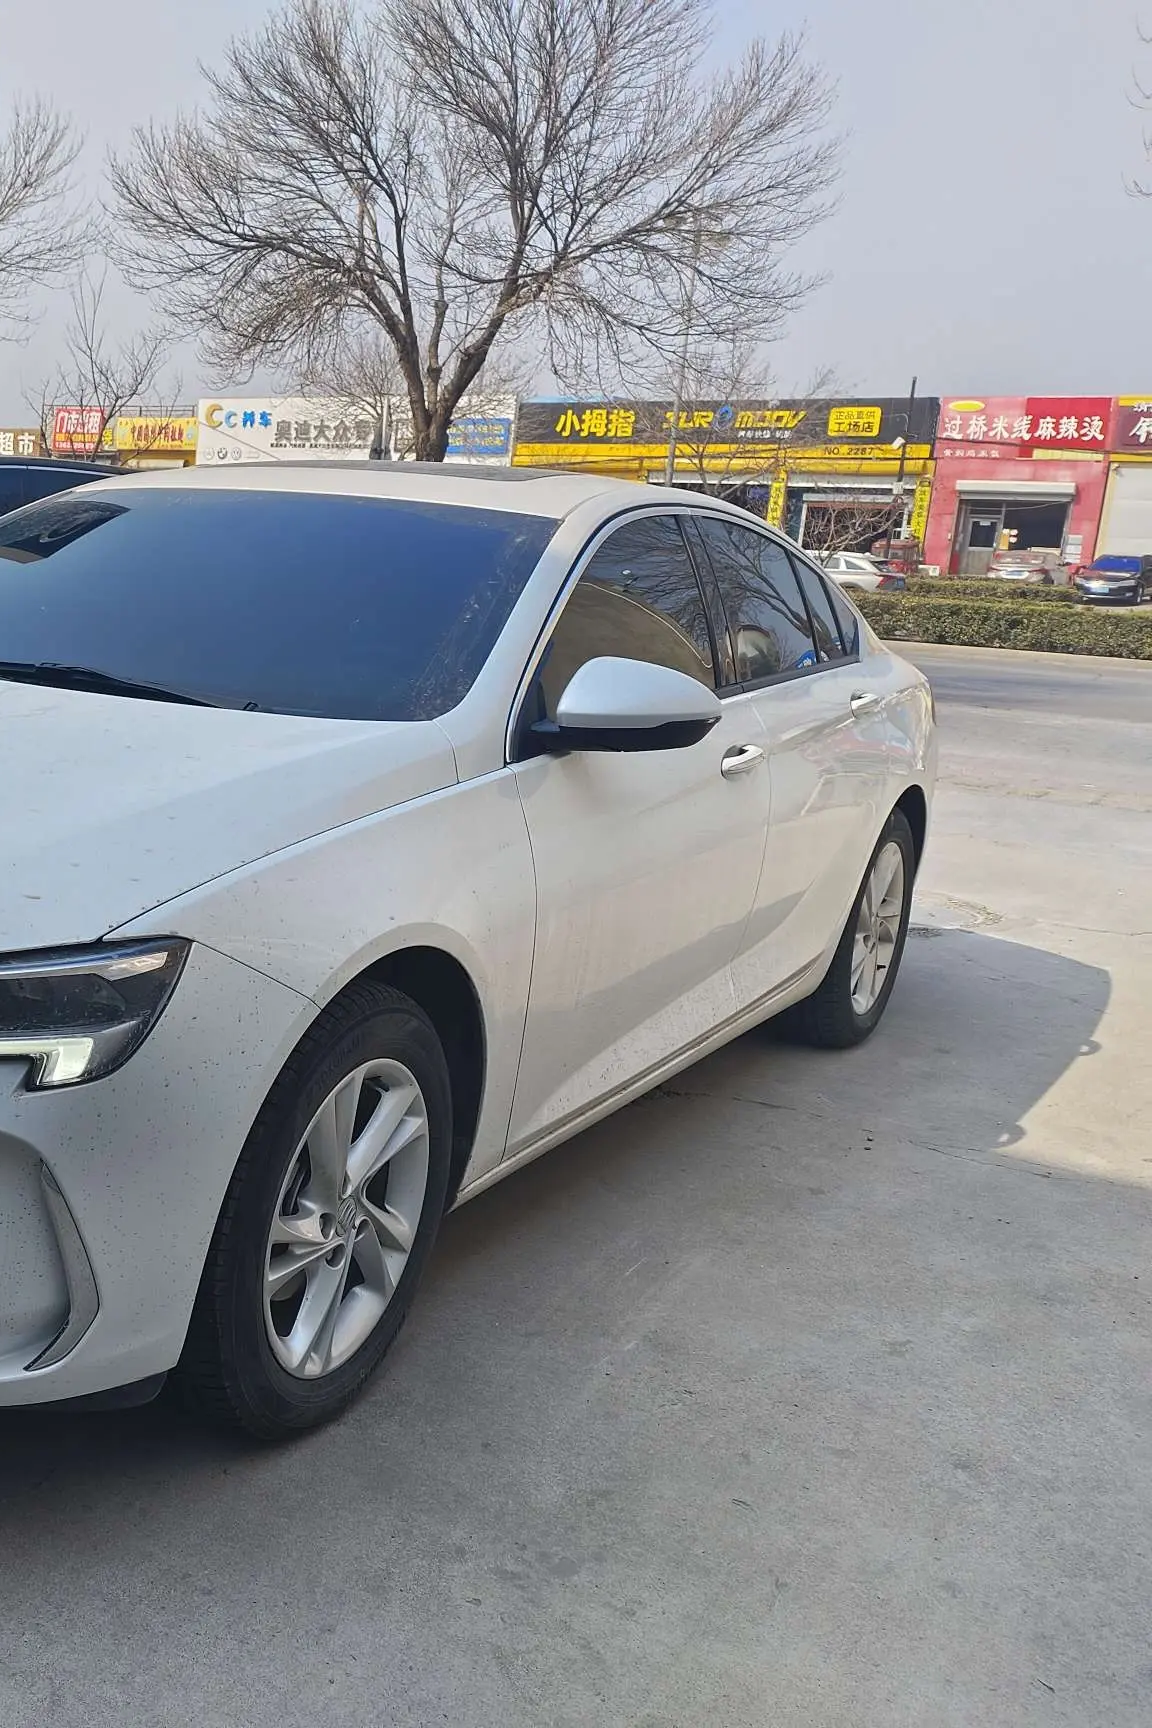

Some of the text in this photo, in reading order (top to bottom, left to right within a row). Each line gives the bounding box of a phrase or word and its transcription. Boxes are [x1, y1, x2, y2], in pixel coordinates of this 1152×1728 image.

[555, 408, 636, 438] 小拇指
[833, 421, 875, 433] 工场店
[942, 414, 1105, 441] 过桥米线麻辣烫
